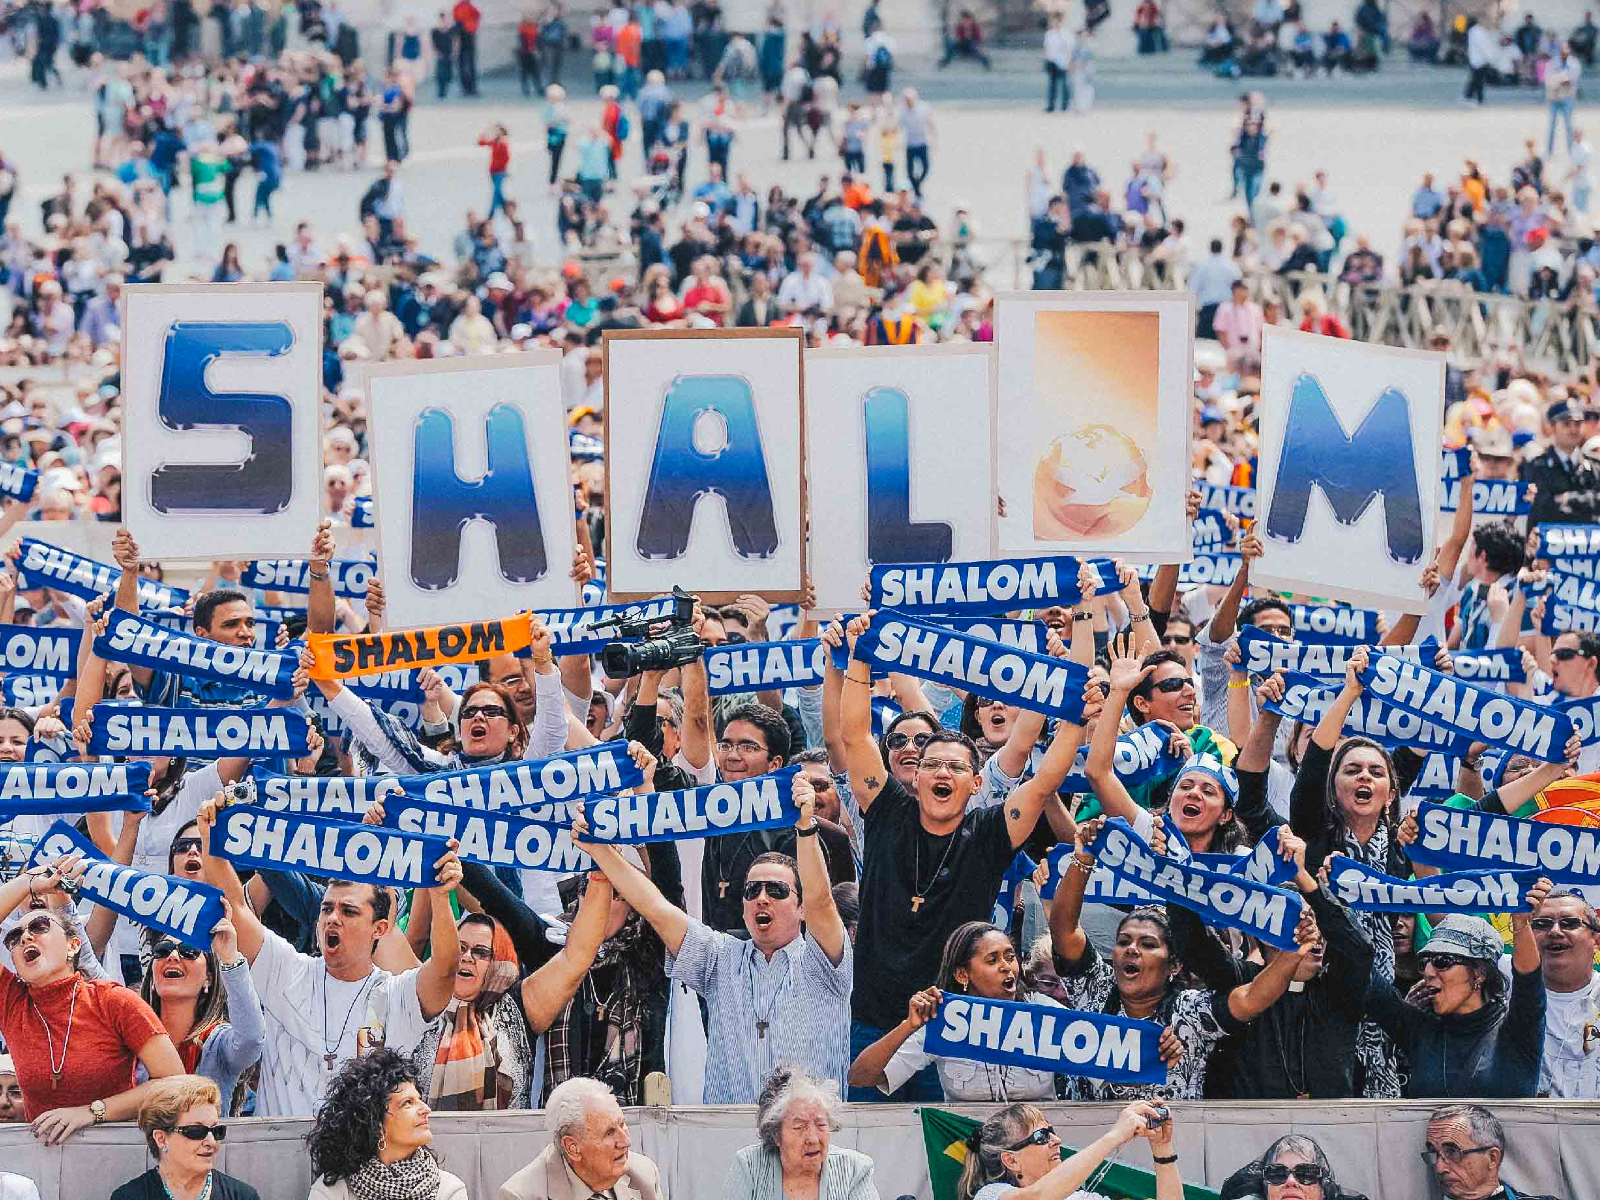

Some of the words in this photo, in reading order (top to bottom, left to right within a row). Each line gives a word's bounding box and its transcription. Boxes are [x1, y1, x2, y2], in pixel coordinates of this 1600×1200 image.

[23, 543, 171, 609] SHALM
[881, 562, 1058, 606] SHALOM
[109, 618, 282, 686] SHALOM
[333, 621, 505, 673] SHALOM
[874, 621, 1068, 708] SHALOM
[1247, 640, 1421, 674] SHALM
[107, 715, 290, 751] SHALOM
[1371, 655, 1555, 757] SHALOM
[425, 751, 622, 811] SHALOM
[593, 779, 782, 840] SHALOM
[223, 812, 423, 883] SHALOM
[399, 808, 592, 872] SHALOM
[1099, 829, 1287, 937] SHALOM
[1337, 869, 1519, 907] SHALOM
[941, 1000, 1141, 1072] SHALOM
